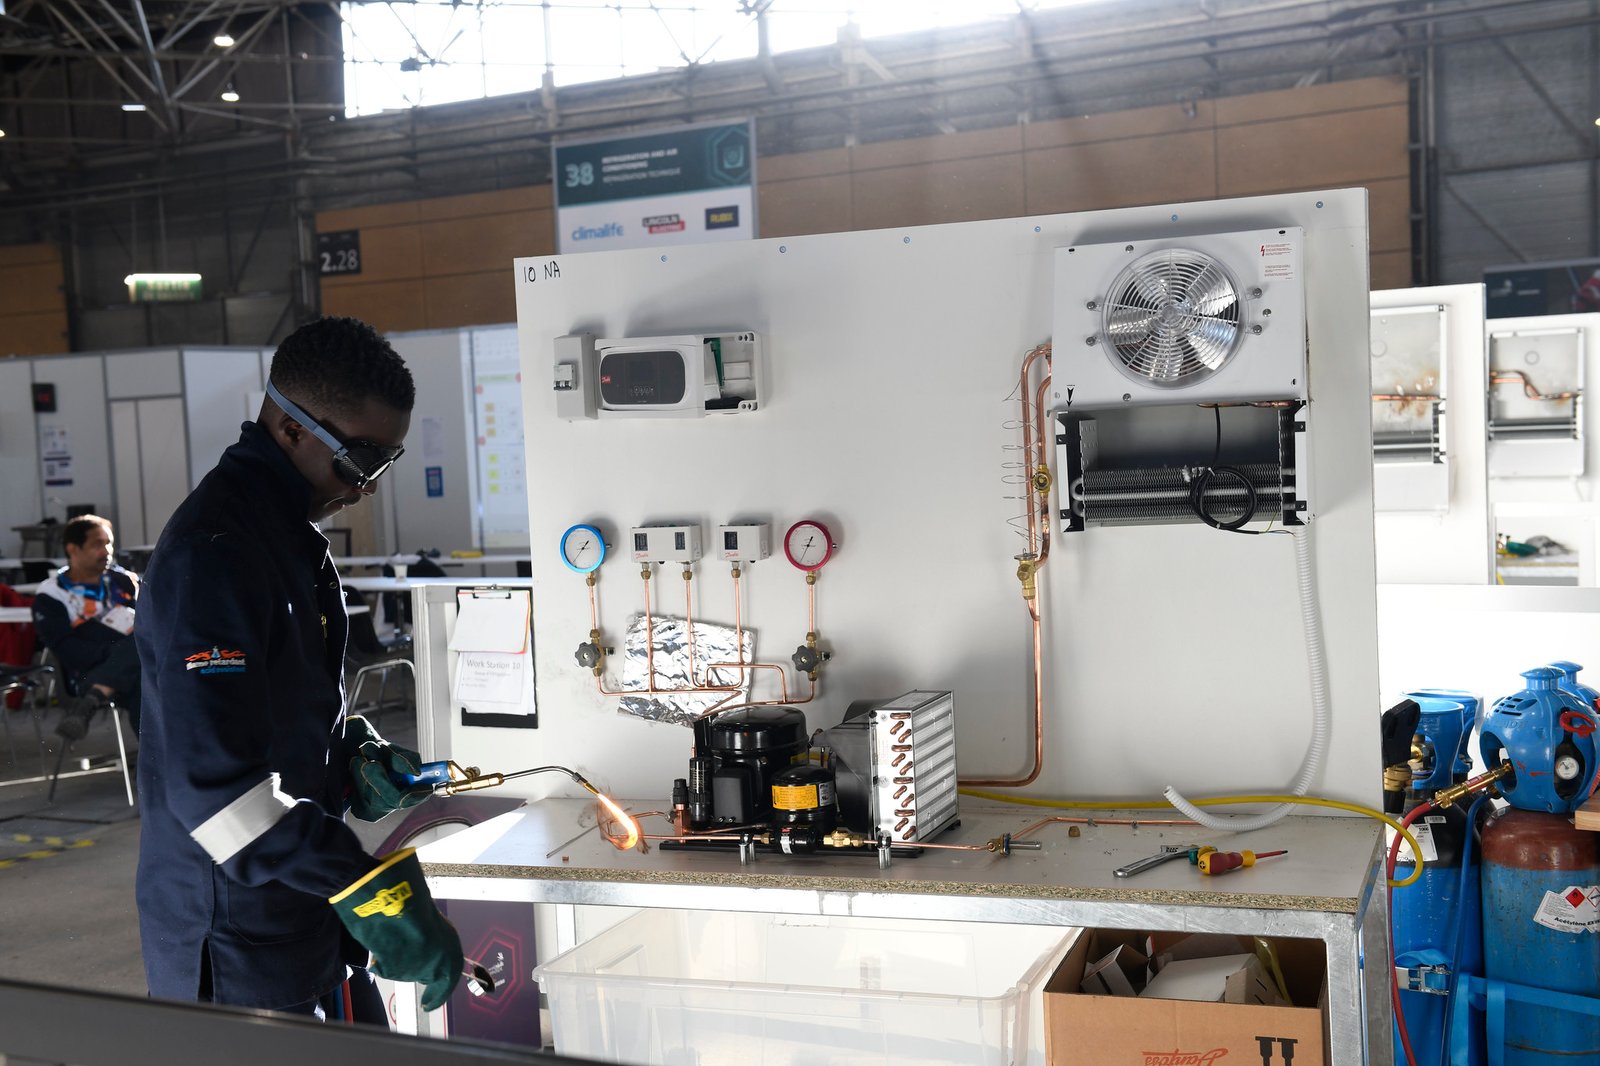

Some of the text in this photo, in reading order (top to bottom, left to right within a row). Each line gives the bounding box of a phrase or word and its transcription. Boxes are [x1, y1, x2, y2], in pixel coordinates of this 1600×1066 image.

[565, 161, 594, 188] 38
[572, 222, 625, 241] climalife
[320, 249, 359, 272] 2.28
[523, 260, 561, 283] 10 NA
[467, 659, 485, 668] Work
[486, 661, 510, 669] Station
